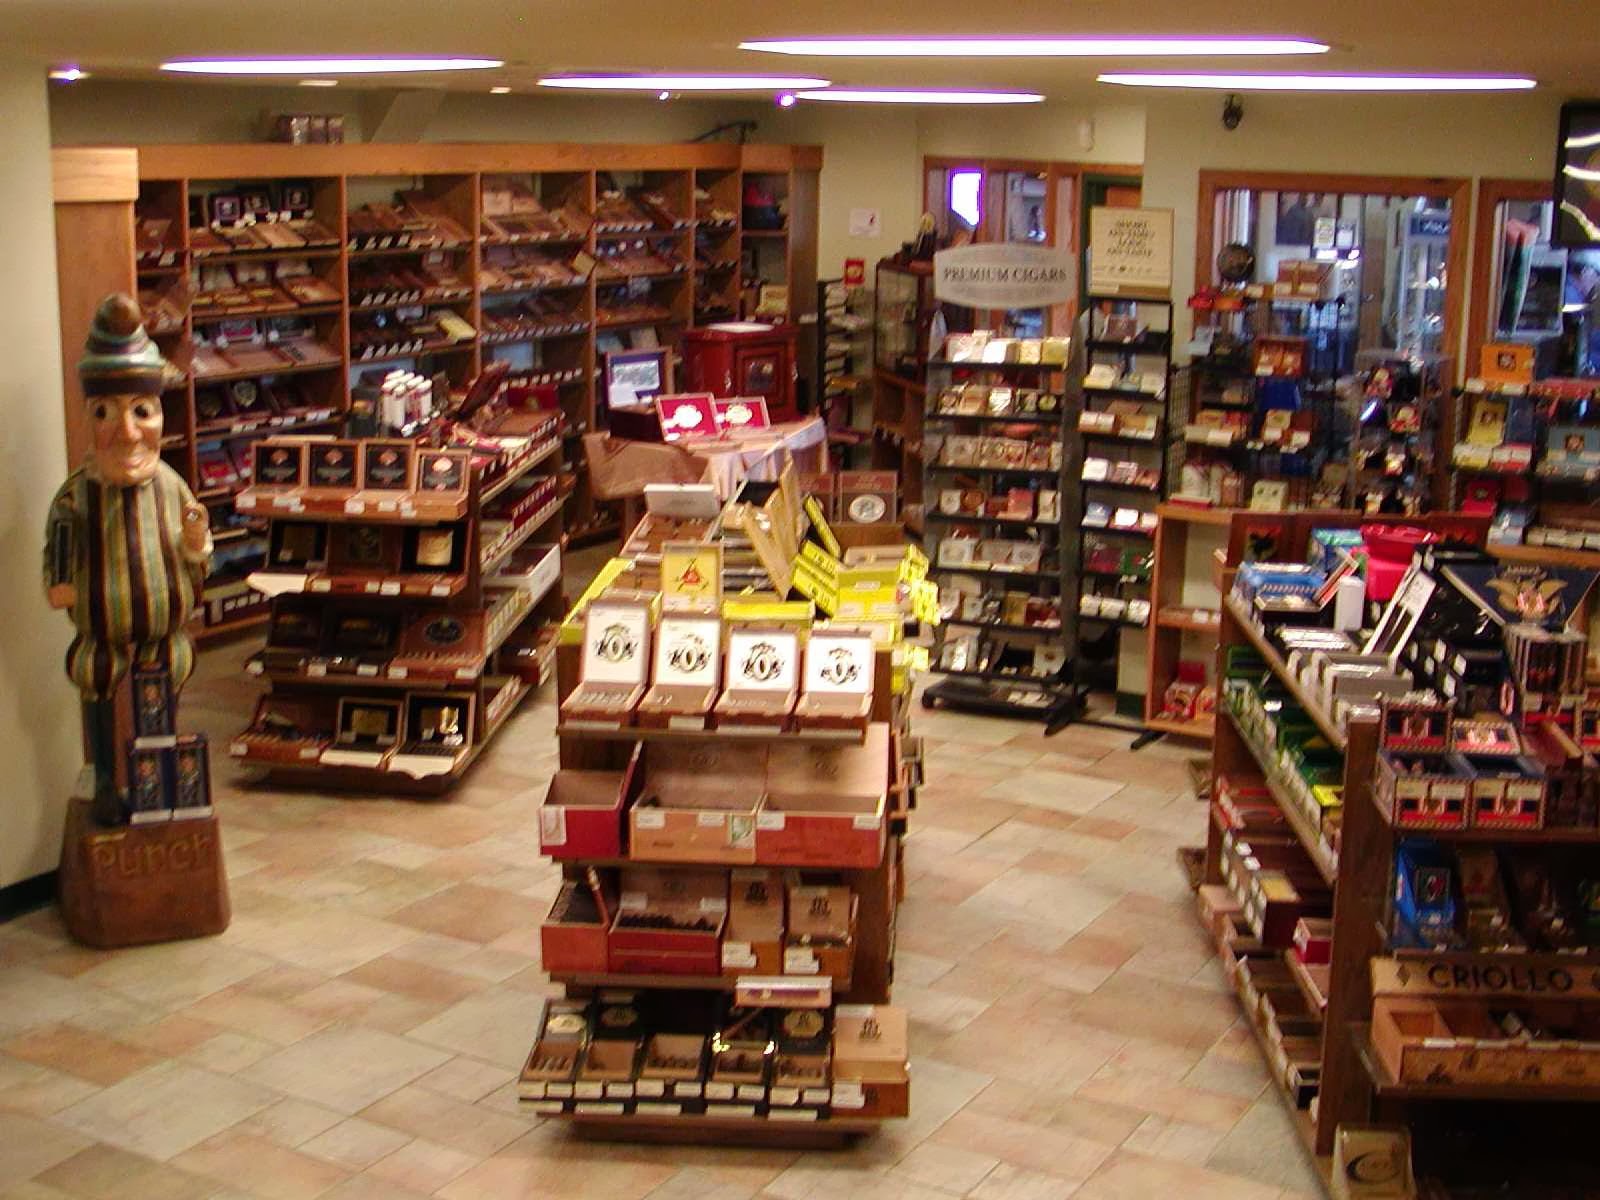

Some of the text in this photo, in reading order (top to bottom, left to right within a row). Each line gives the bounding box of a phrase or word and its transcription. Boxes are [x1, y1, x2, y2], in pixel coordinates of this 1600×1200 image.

[943, 266, 1067, 282] PREMIUM CIGARS
[1428, 964, 1573, 991] CRIOLLO
